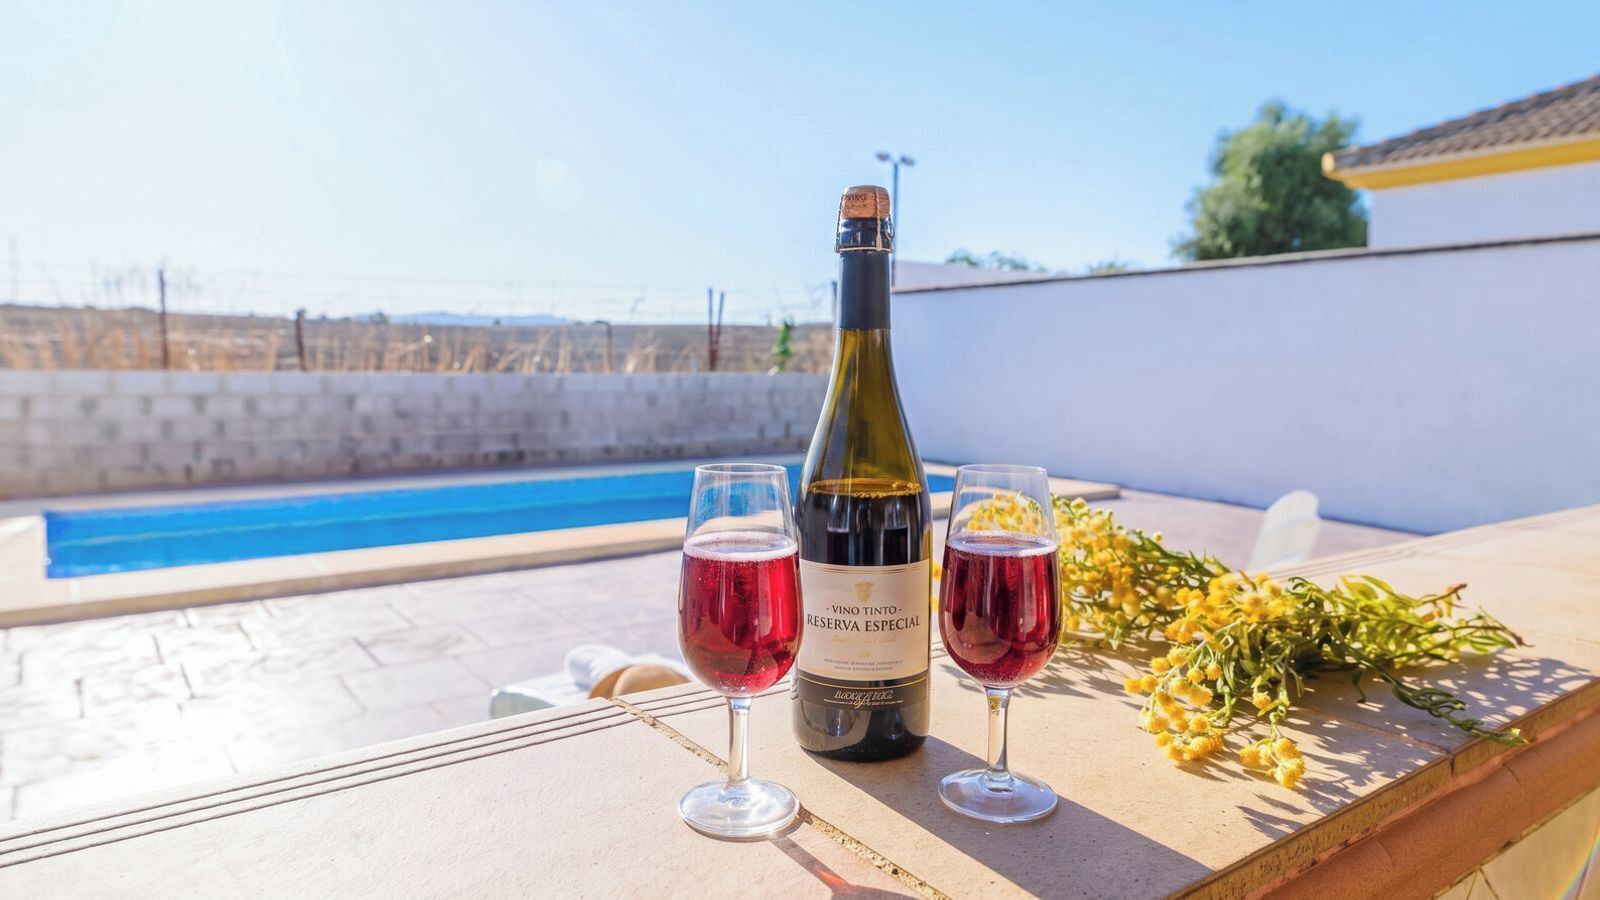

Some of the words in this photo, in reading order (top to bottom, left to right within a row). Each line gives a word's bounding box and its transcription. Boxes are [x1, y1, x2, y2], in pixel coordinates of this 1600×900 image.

[832, 605, 860, 615] VINO
[863, 605, 897, 615] TINTO
[807, 613, 860, 632] RESERVA
[865, 615, 920, 632] ESPECIAL
